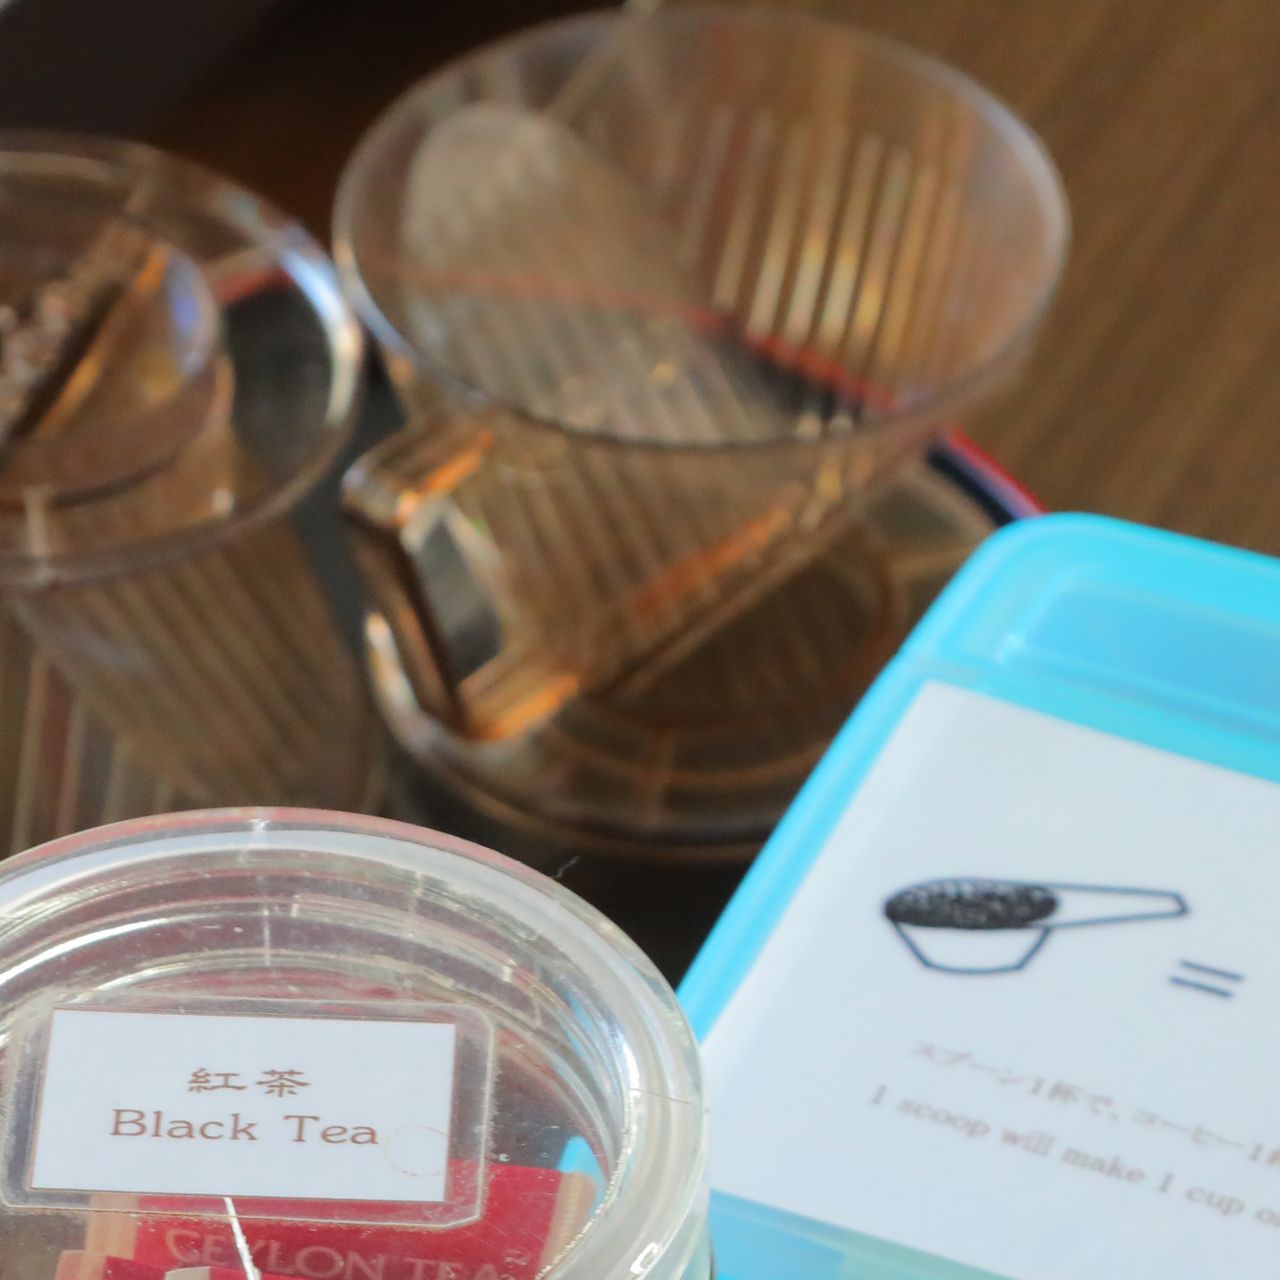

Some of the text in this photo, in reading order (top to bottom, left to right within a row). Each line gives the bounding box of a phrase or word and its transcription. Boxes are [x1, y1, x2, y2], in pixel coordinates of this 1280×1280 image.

[186, 1067, 312, 1098] 紅茶
[109, 1108, 380, 1145] Black Tea
[896, 1098, 991, 1138] scoop
[1000, 1128, 1057, 1157] will
[1061, 1147, 1147, 1184] make
[1185, 1186, 1247, 1217] cup
